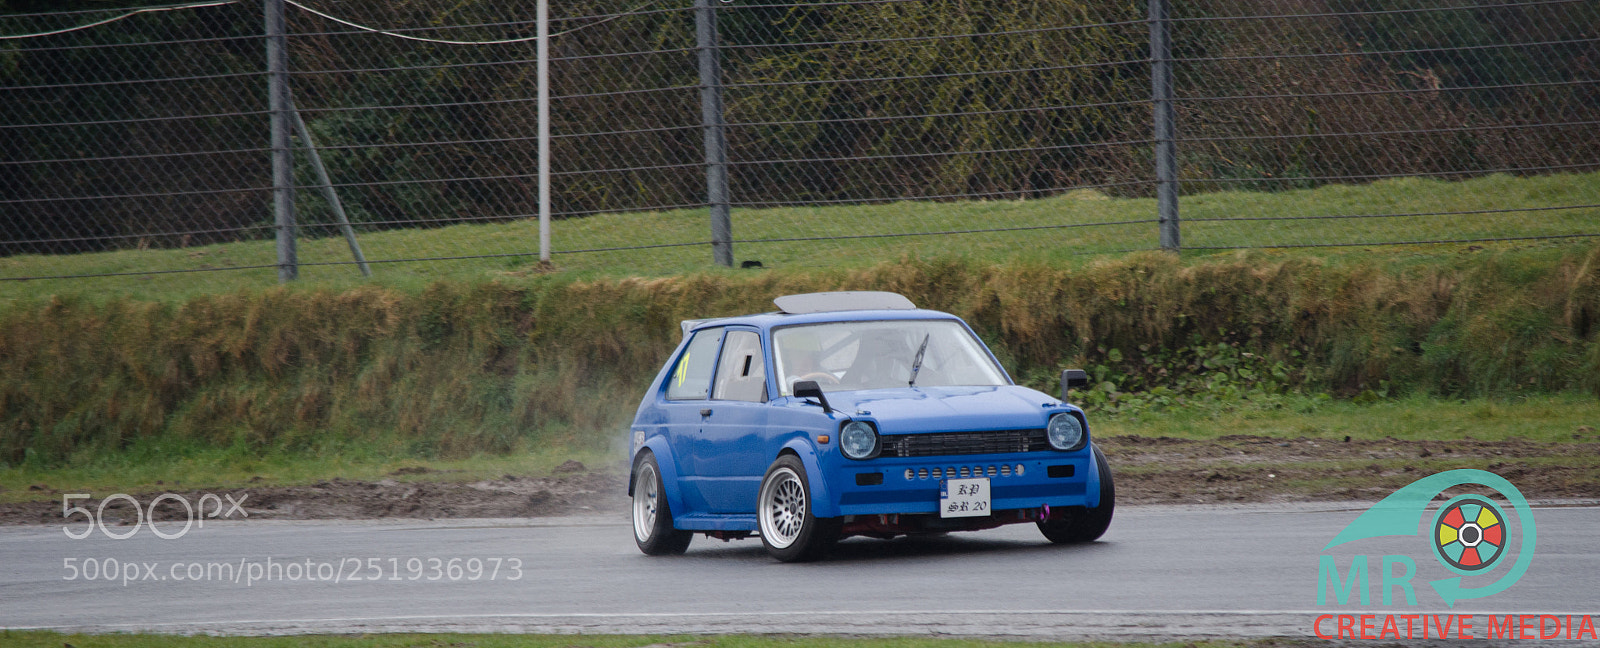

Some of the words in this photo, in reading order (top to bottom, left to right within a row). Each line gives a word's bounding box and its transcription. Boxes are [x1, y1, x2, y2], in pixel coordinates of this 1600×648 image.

[957, 483, 980, 497] KP
[947, 501, 969, 513] SR
[972, 500, 987, 511] 20
